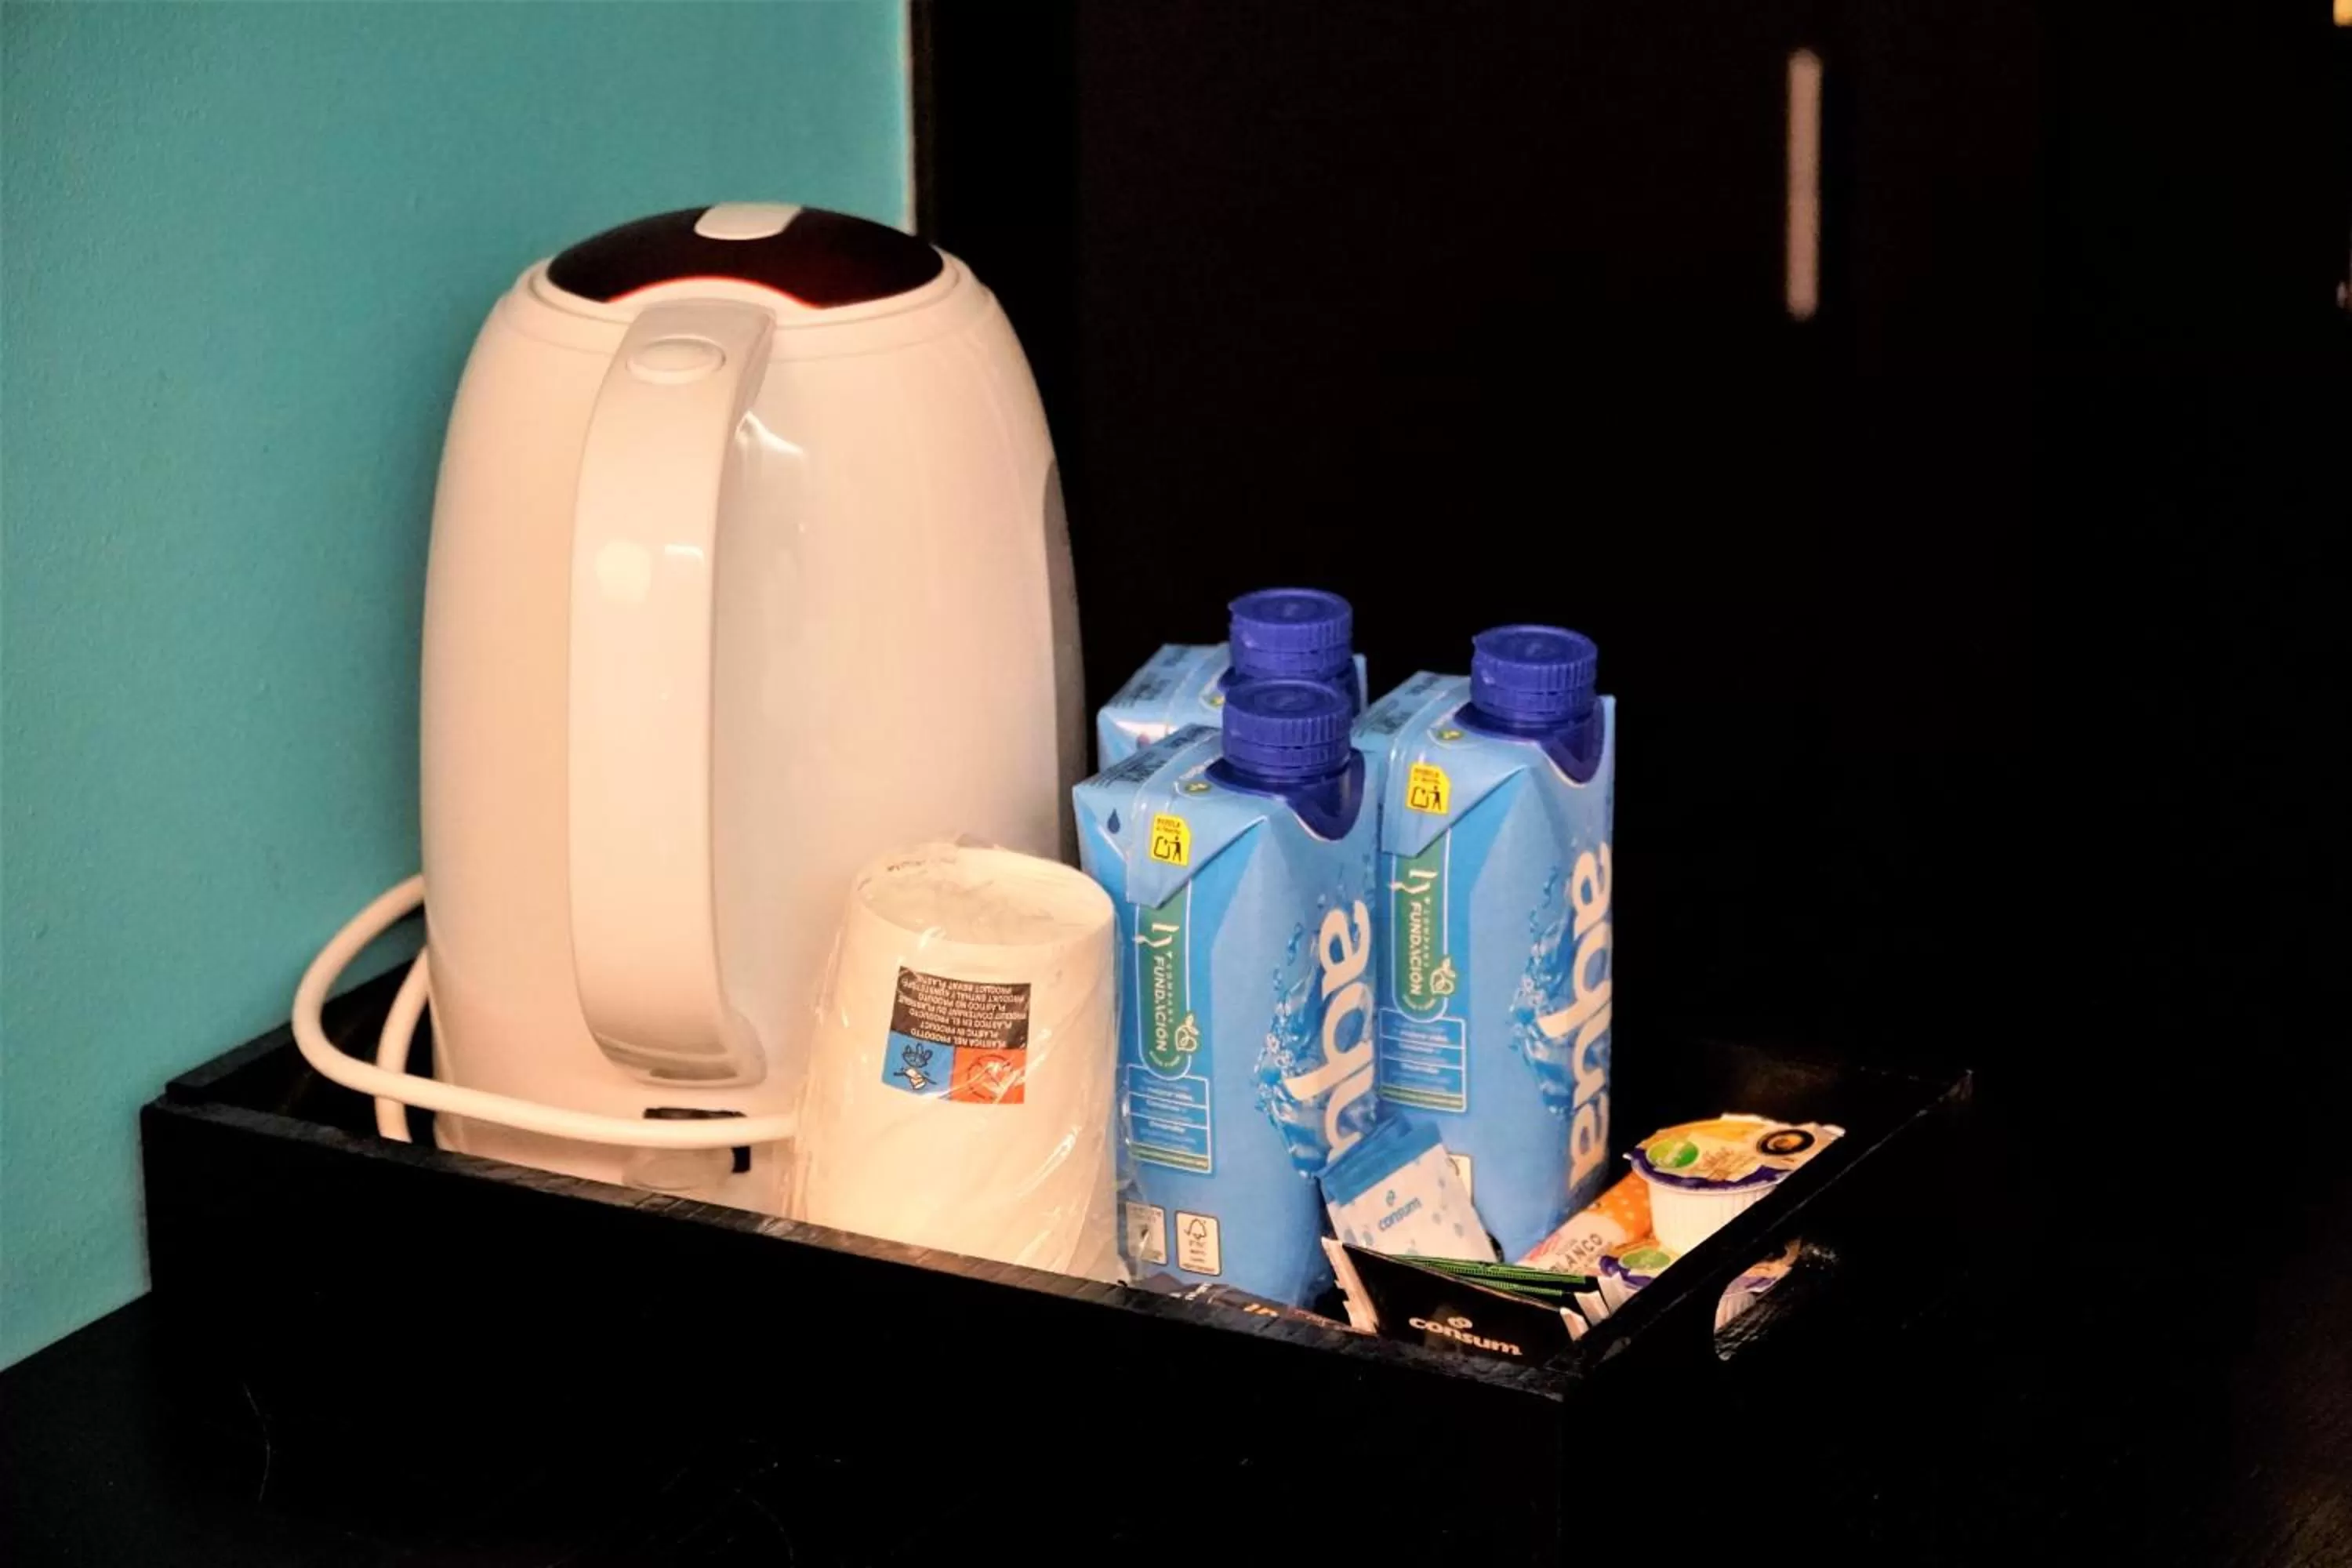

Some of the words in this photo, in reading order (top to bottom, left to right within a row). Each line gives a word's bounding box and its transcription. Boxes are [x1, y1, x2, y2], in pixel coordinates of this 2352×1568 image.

[910, 1029, 951, 1043] PRODOTTO
[966, 1029, 998, 1038] PLASTIC
[1283, 900, 1374, 1163] aqu
[1409, 1316, 1523, 1356] consum
